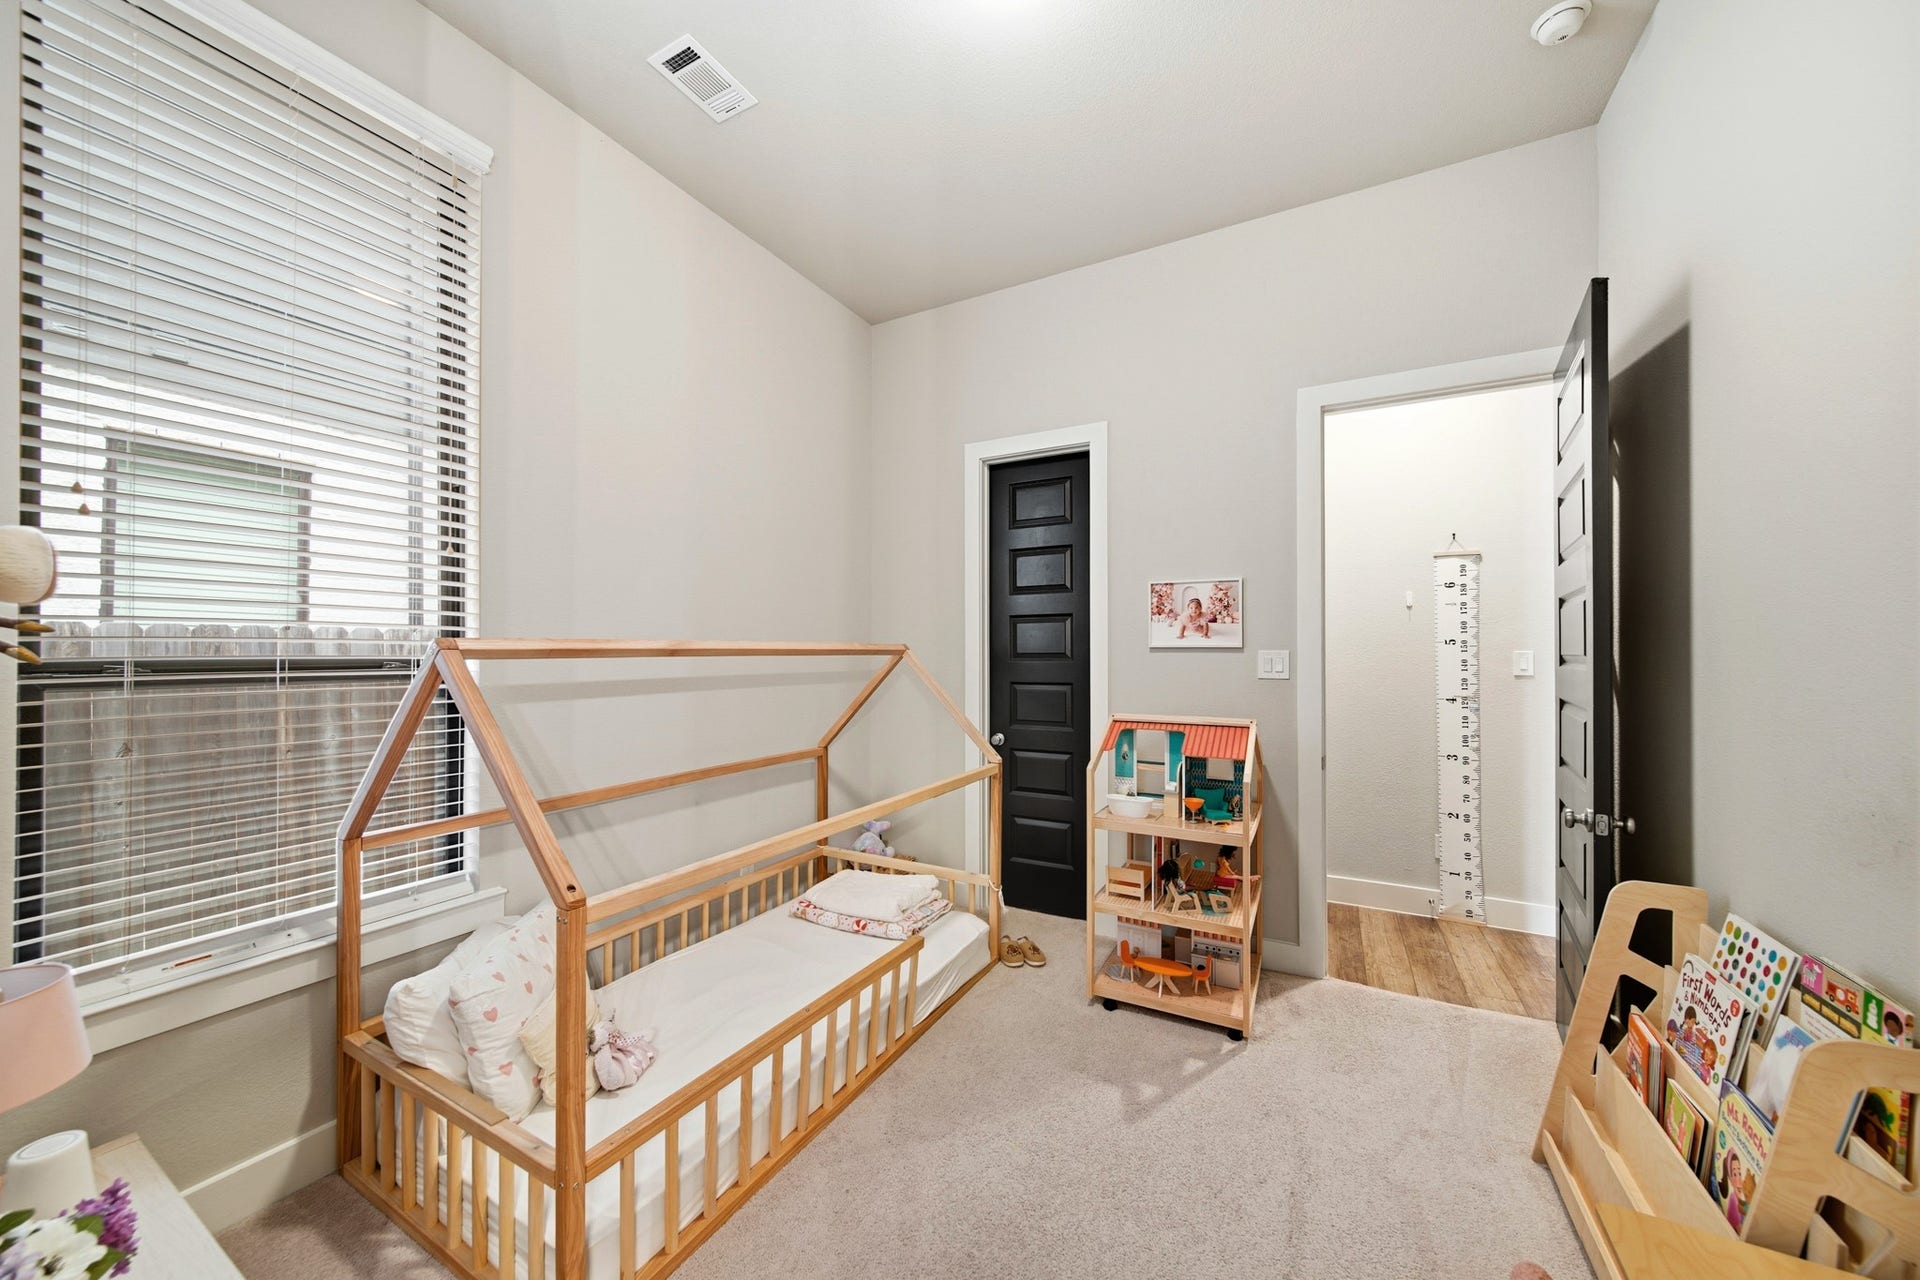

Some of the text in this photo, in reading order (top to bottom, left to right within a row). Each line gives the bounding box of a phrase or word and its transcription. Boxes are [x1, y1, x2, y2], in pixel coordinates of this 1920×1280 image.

[1463, 756, 1470, 765] 90
[1463, 775, 1470, 784] 80
[1463, 794, 1470, 803] 70
[1464, 814, 1471, 823] 60
[1464, 833, 1471, 842] 50
[1465, 853, 1471, 861] 40
[1465, 872, 1472, 880] 30
[1466, 891, 1472, 899] 20
[1466, 910, 1473, 918] 10
[1682, 973, 1703, 993] First
[1704, 984, 1731, 1028] Words
[1690, 992, 1721, 1032] Numbers
